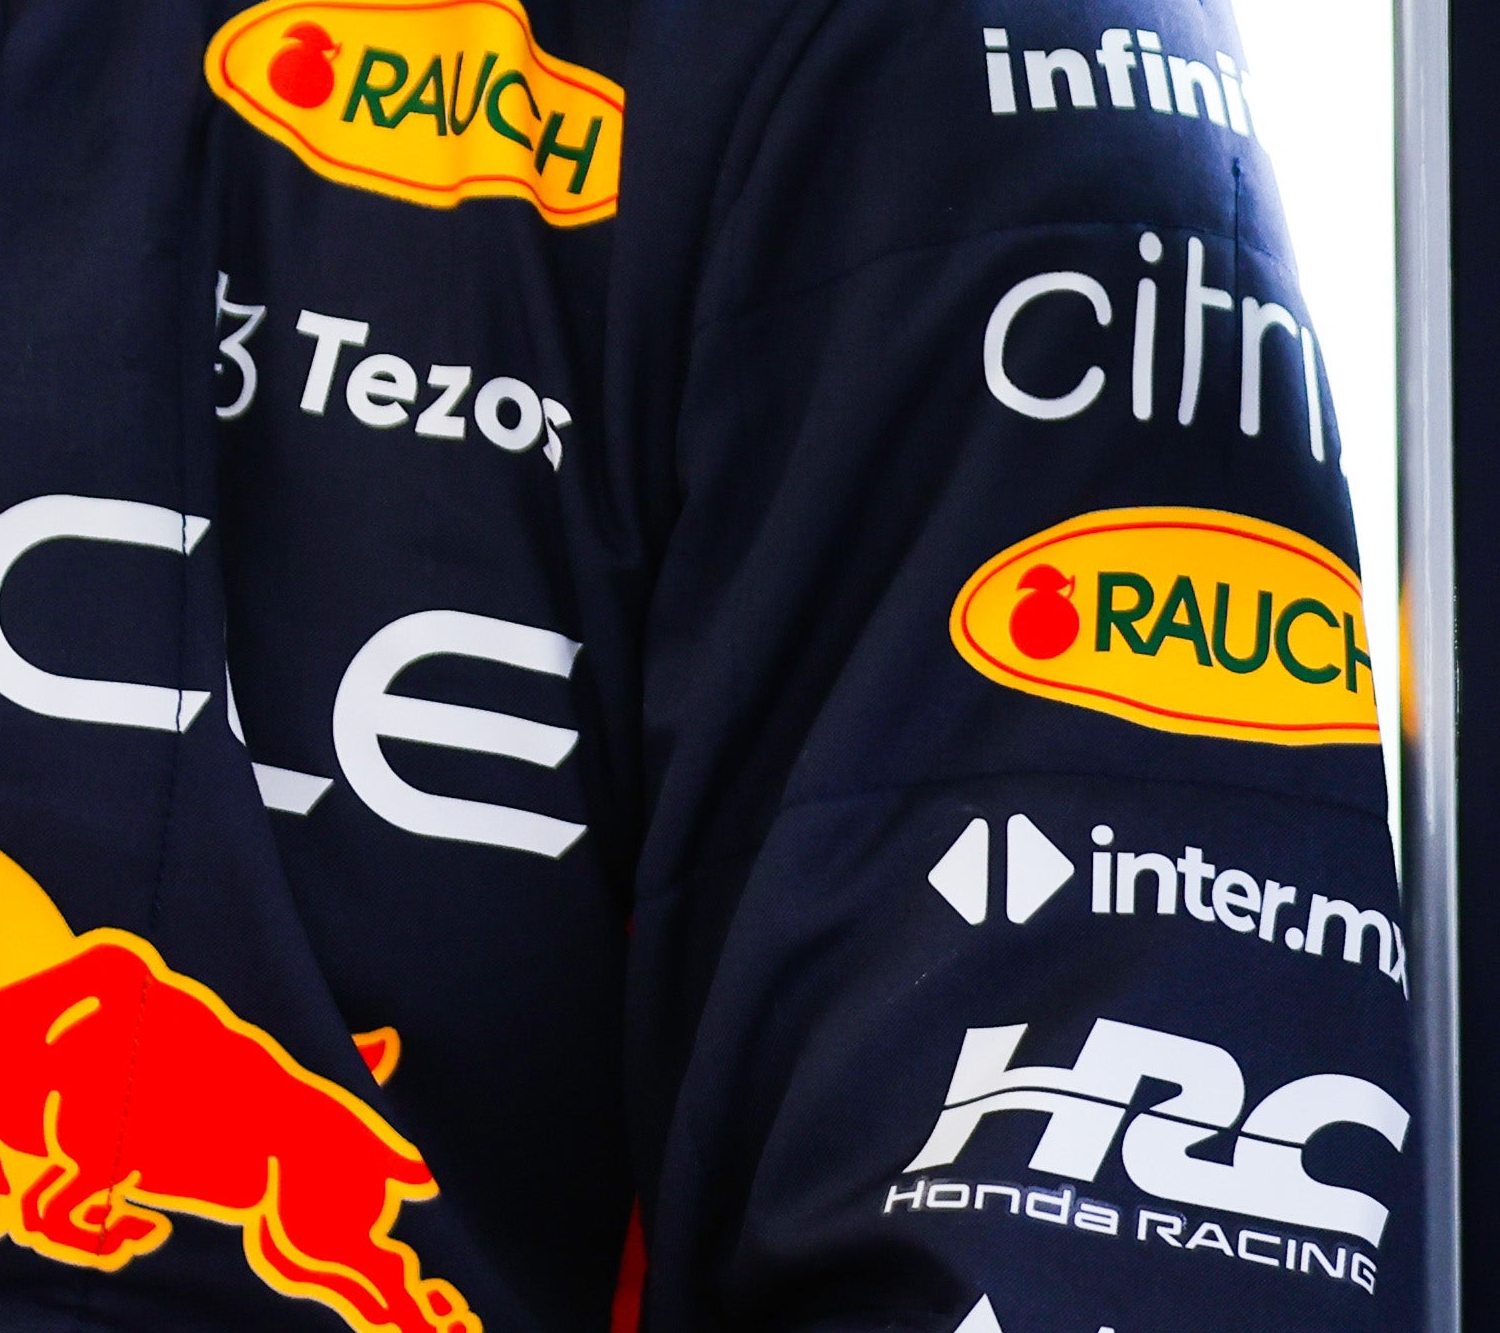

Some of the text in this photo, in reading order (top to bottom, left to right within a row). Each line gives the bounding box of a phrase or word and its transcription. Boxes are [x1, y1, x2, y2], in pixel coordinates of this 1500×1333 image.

[340, 44, 604, 196] RAUCH
[982, 26, 1252, 138] infini
[902, 1017, 1412, 1250] HRC
[883, 1178, 1376, 1296] Honda RACING
